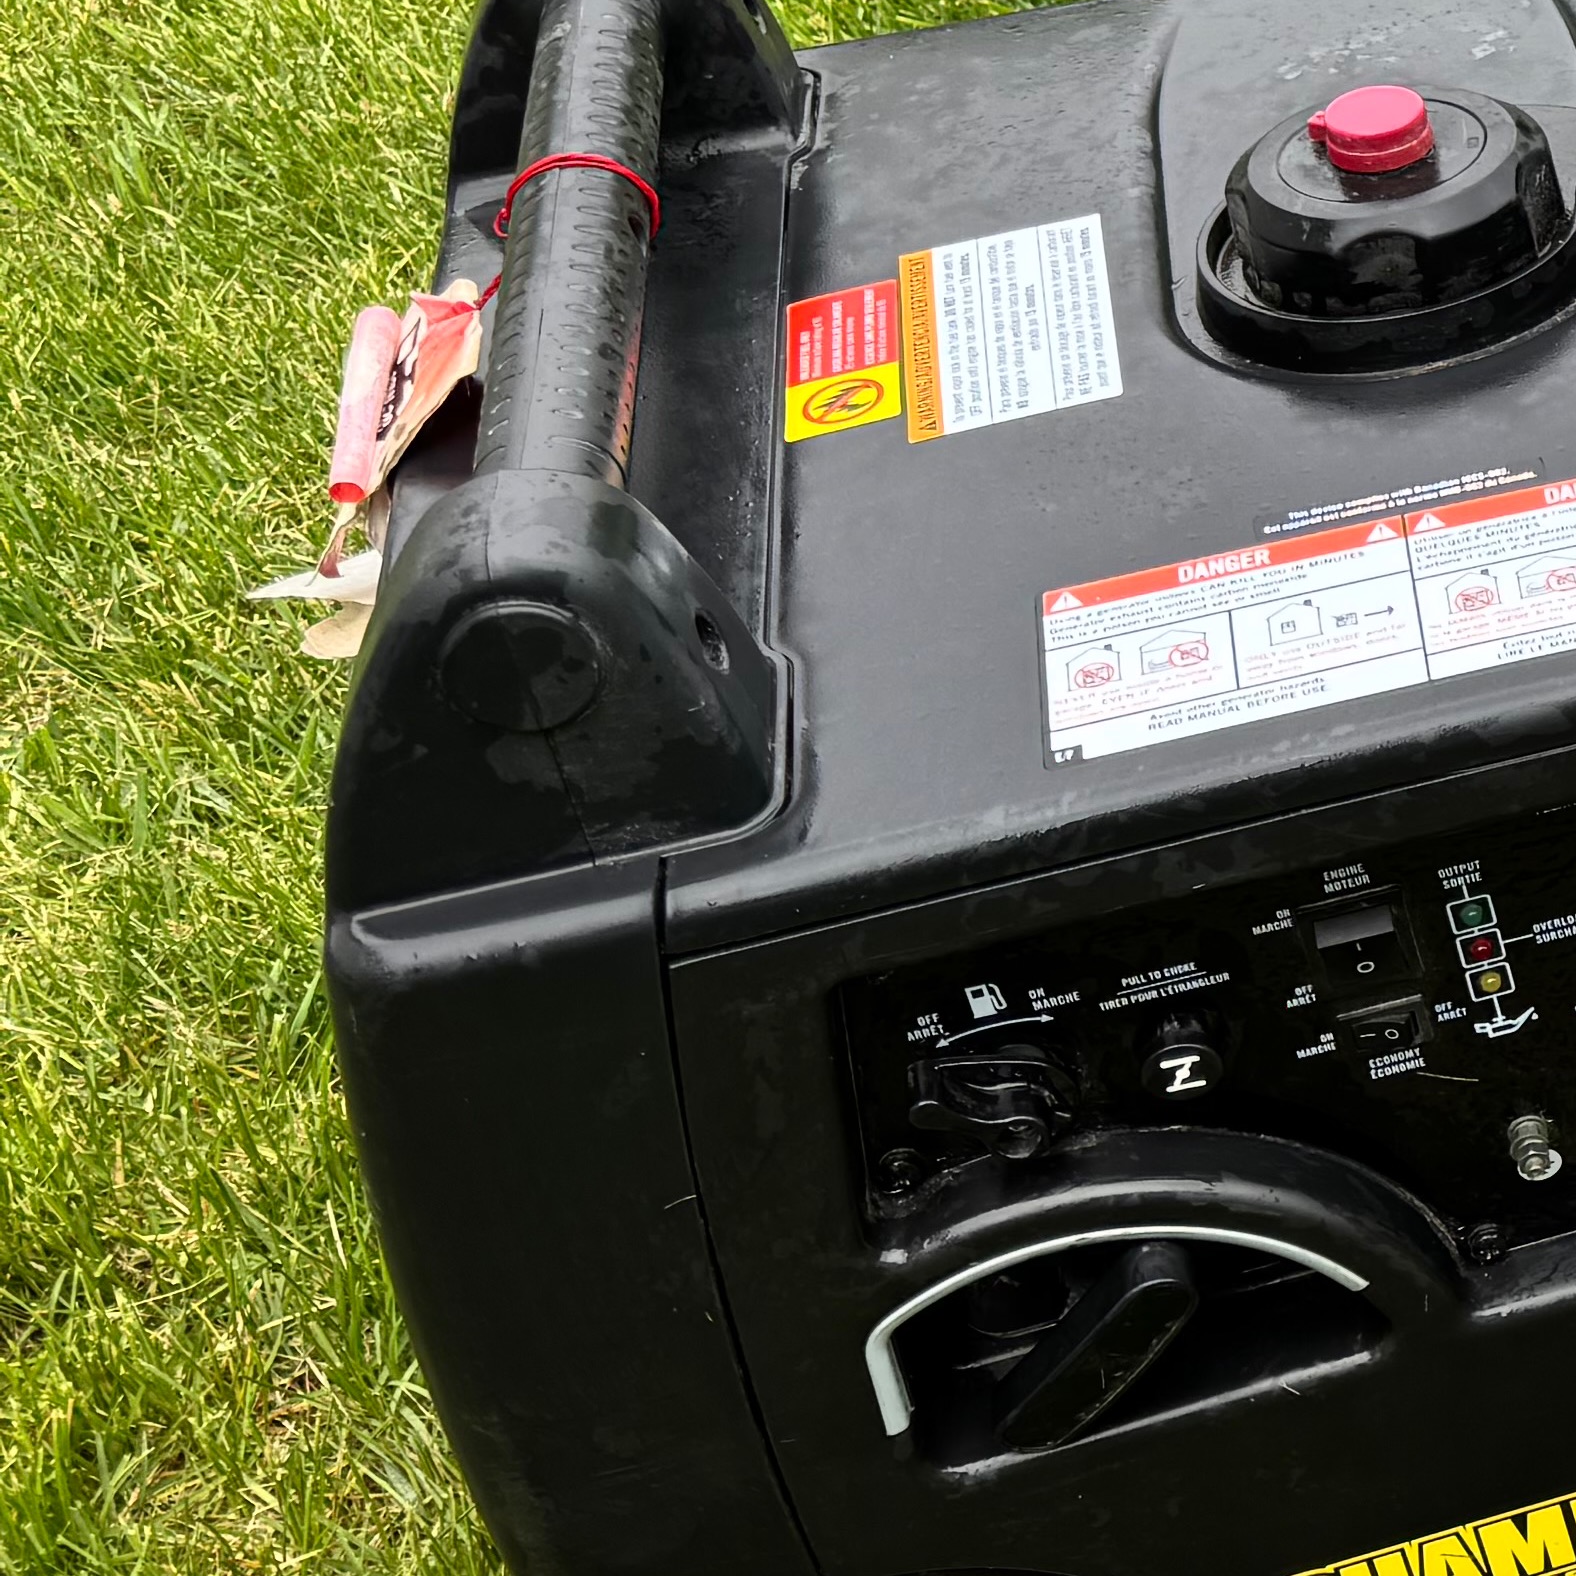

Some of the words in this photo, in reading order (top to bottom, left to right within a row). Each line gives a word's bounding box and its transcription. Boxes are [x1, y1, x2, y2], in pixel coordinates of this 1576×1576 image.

[1177, 548, 1271, 584] DANGER
[1323, 863, 1366, 882] ENGINE
[1437, 860, 1481, 879] OUTPUT
[1323, 874, 1371, 894] MOTEUR
[1442, 872, 1483, 890] SORTIE
[1276, 908, 1291, 920] ON
[1252, 918, 1294, 936] MARCHE
[1121, 973, 1147, 988] PULL
[1148, 970, 1162, 981] TO
[1028, 987, 1046, 1000] ON
[1294, 984, 1314, 997] OFF
[1032, 991, 1081, 1011] MARCHE
[1099, 997, 1129, 1012] TIRER
[1130, 990, 1159, 1004] POUR
[1434, 1001, 1453, 1013] OFF
[916, 1013, 940, 1027] OFF
[1320, 1032, 1334, 1043] ON
[1296, 1042, 1337, 1059] MARCHE
[1368, 1047, 1421, 1069] ECONOMY
